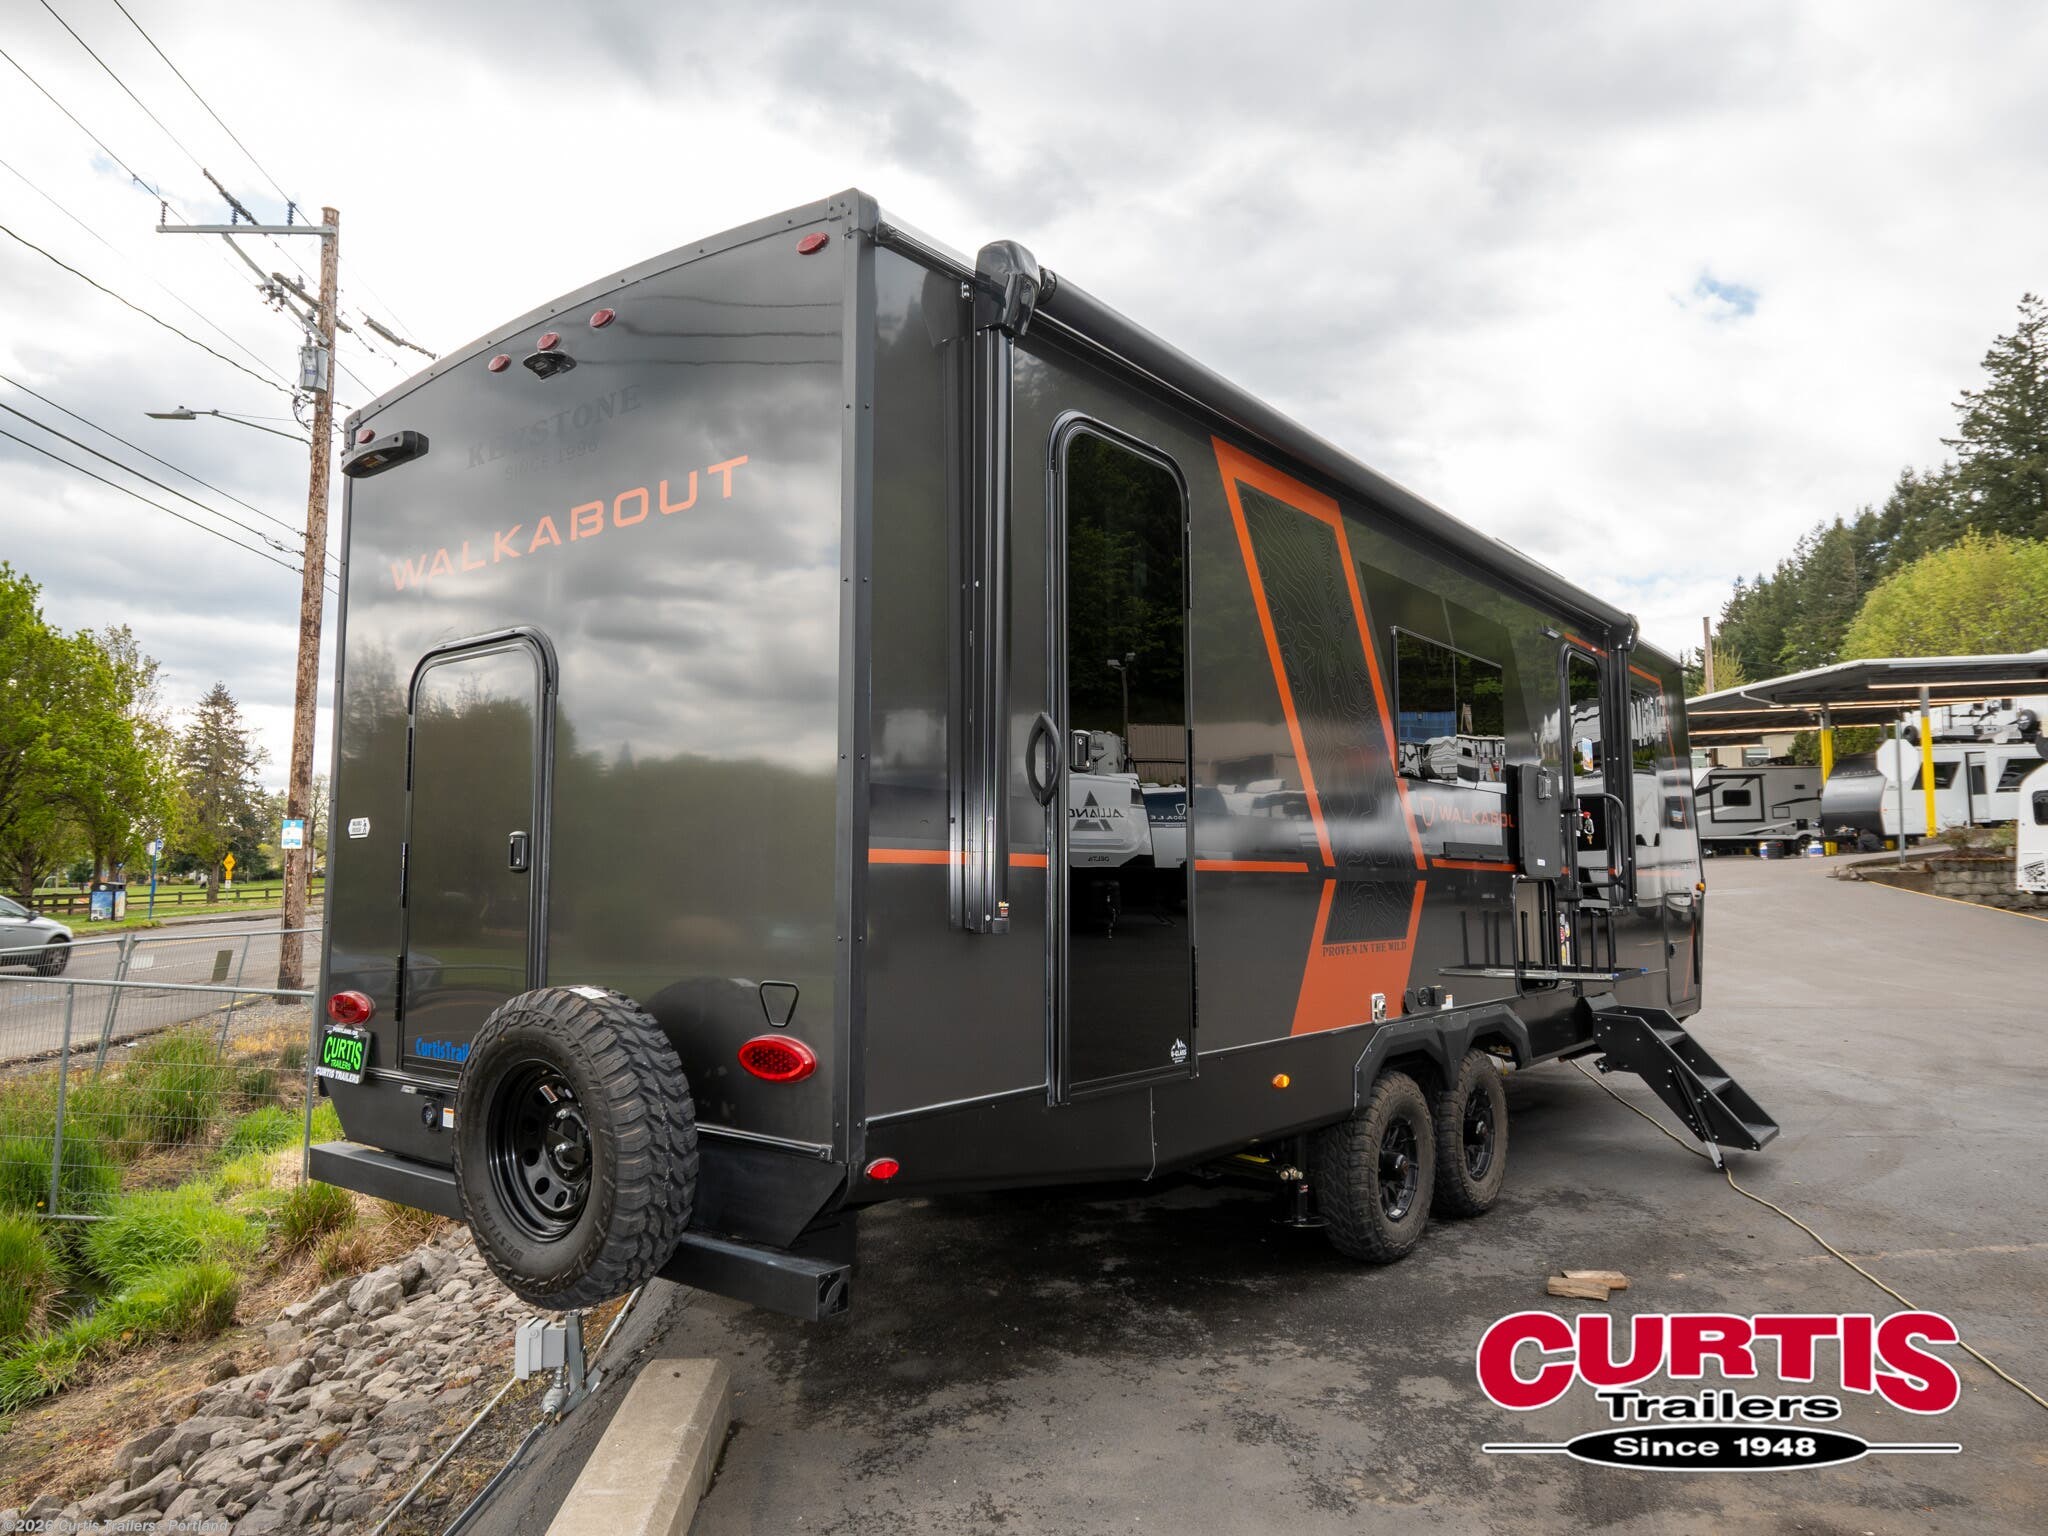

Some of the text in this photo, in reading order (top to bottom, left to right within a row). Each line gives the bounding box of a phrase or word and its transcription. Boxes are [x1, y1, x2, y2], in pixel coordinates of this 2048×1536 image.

[467, 385, 641, 469] KEYSTONE
[505, 455, 552, 481] SINCE
[390, 455, 749, 591] WALKABOUT
[1322, 941, 1407, 957] PROVEN IN THE WILD
[324, 1036, 363, 1070] CURTIS
[330, 1059, 351, 1071] TRAILERS
[315, 1066, 361, 1084] CURTIS TRAILERS
